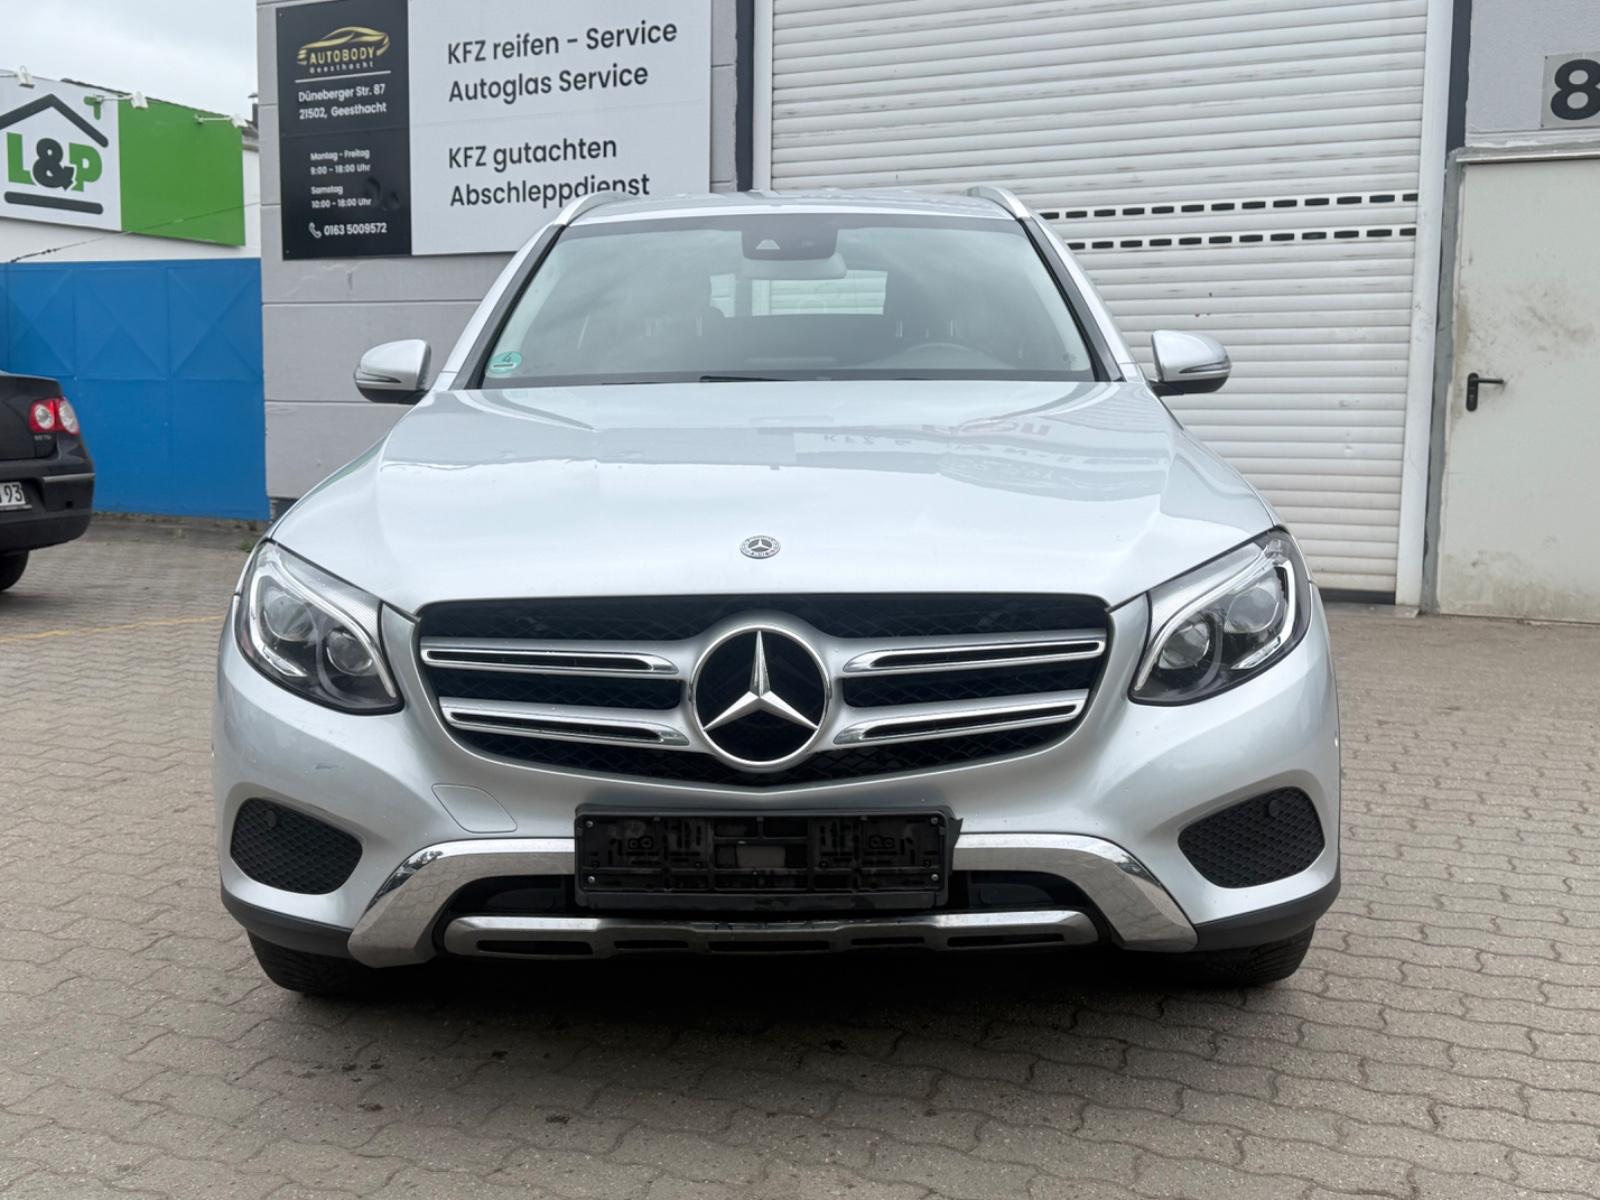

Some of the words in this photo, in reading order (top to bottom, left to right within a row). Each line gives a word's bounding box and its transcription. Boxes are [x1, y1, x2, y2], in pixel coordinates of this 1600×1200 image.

[447, 40, 486, 64] KFZ
[493, 32, 559, 60] reifen
[586, 20, 677, 50] Service
[309, 46, 375, 64] AUTOBODY
[298, 88, 354, 101] Düneberger
[356, 85, 372, 97] Str.
[373, 83, 386, 95] 87
[448, 73, 552, 104] Autoglas
[559, 63, 648, 92] Service
[1550, 58, 1600, 120] 8
[299, 107, 328, 120] 21502,
[330, 102, 387, 117] Geesthacht
[6, 132, 103, 192] L&P
[310, 151, 338, 162] Montag
[344, 148, 370, 159] Freitag
[448, 145, 487, 168] KFZ
[493, 138, 617, 173] gutachten
[356, 163, 371, 172] Uhr
[311, 185, 343, 195] Samstag
[450, 174, 650, 208] Abschleppdienst
[358, 197, 372, 206] Uhr
[324, 224, 345, 236] 0163
[346, 222, 387, 235] 5009572
[0, 485, 22, 503] 93
